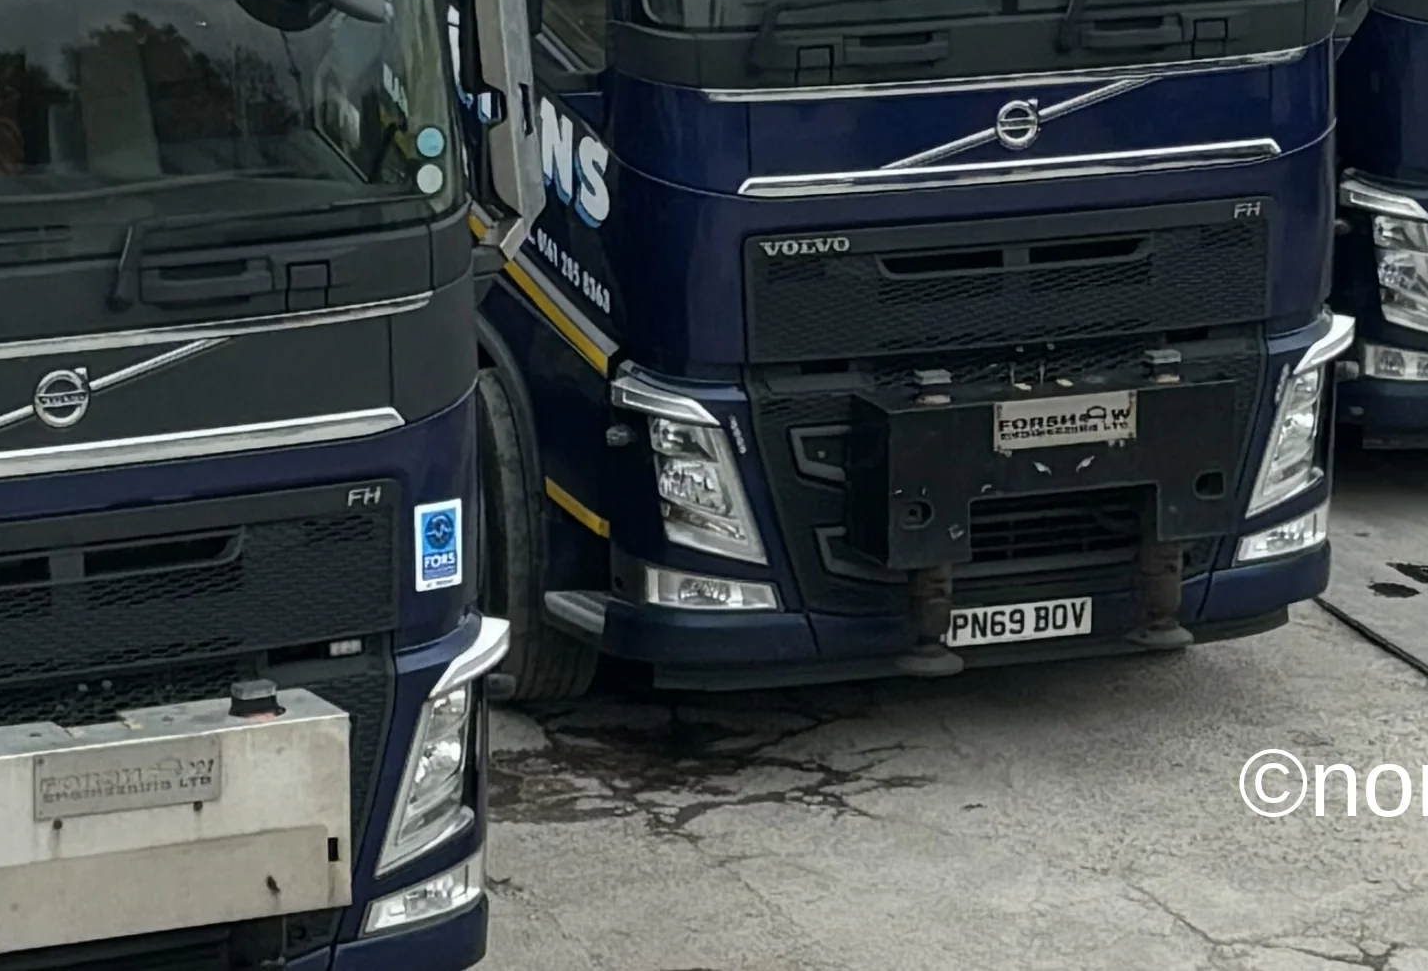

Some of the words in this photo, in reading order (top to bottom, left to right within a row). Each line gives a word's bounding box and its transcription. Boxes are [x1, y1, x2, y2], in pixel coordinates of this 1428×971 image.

[759, 235, 851, 257] VOLVO
[1233, 201, 1261, 219] FH
[582, 271, 610, 314] 8363
[347, 485, 382, 508] FH
[424, 552, 455, 569] FORS
[951, 608, 1026, 642] PN69
[1033, 600, 1088, 633] BOV
[179, 776, 212, 789] LTD
